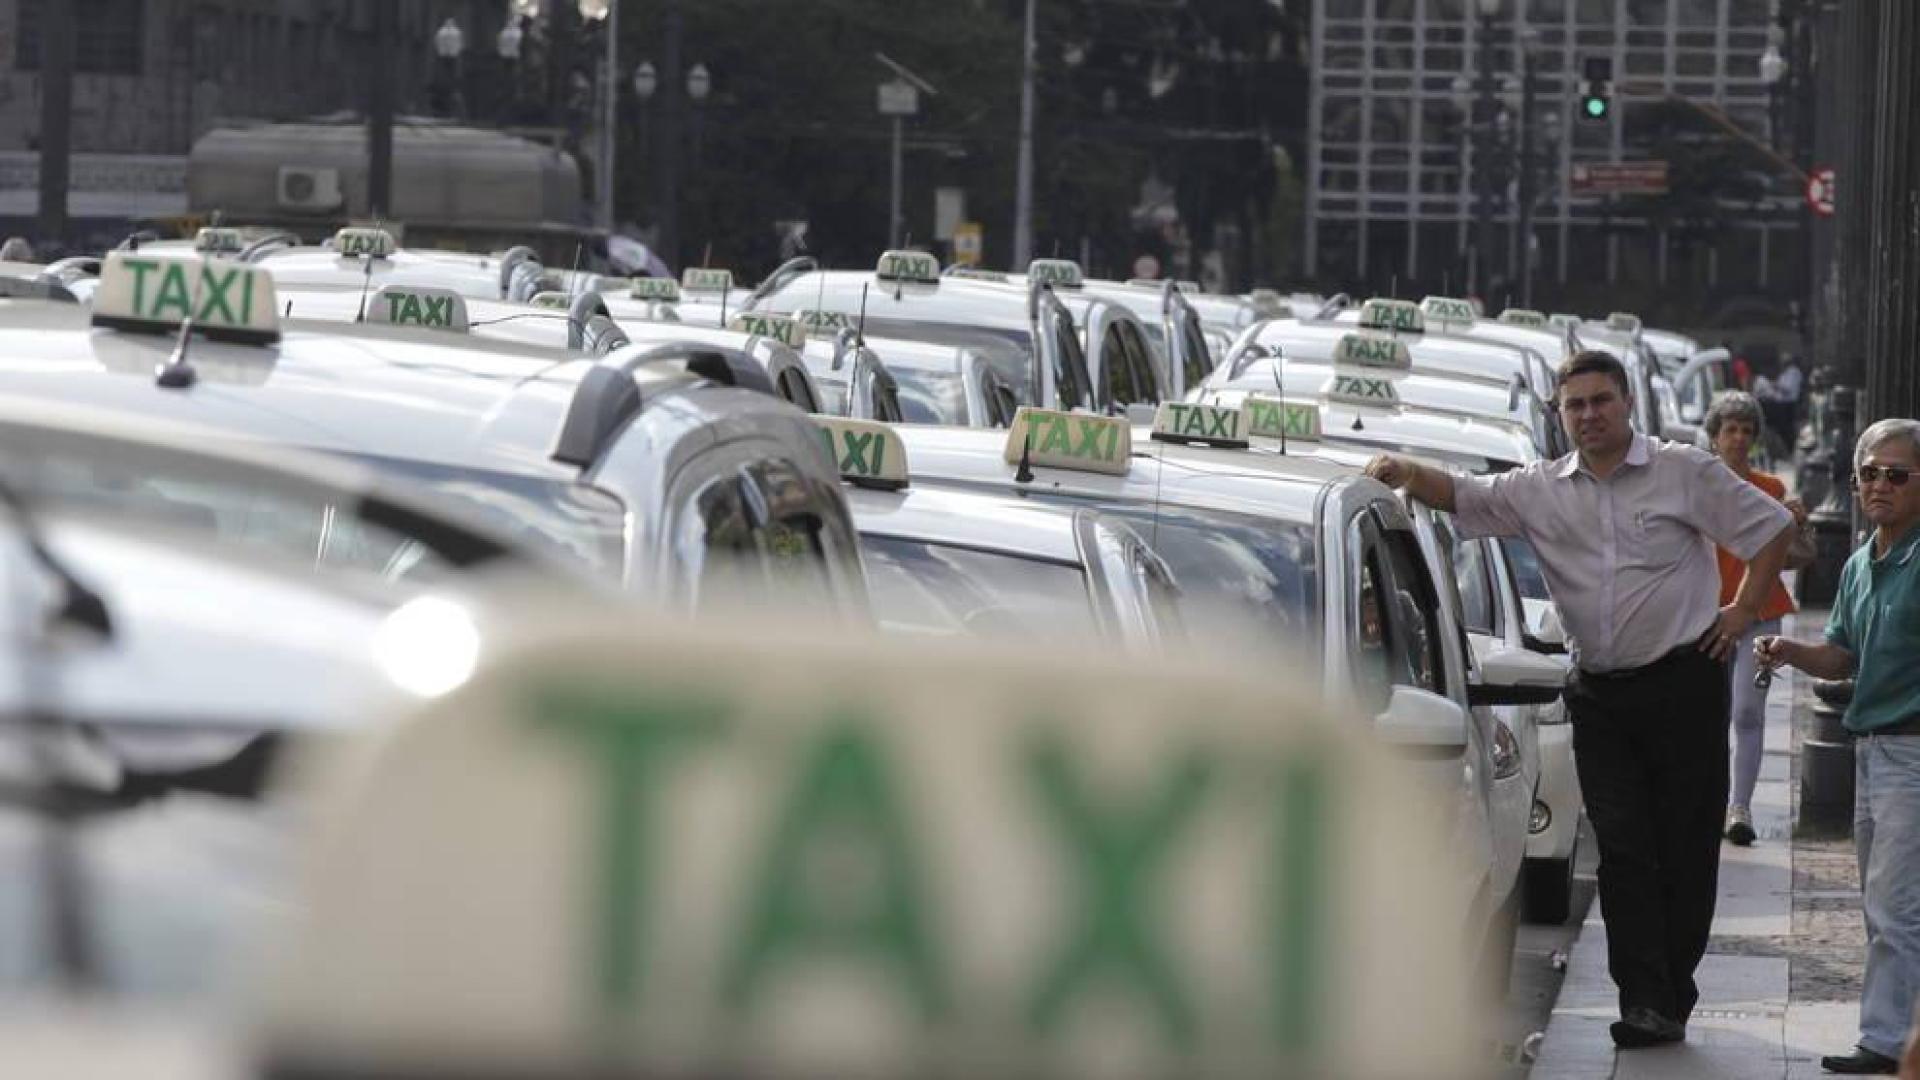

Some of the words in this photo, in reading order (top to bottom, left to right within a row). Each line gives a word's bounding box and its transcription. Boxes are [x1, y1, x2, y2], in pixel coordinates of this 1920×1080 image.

[341, 234, 386, 254] TAXI
[890, 256, 932, 277] TAXI
[122, 261, 255, 326] TAXI
[384, 292, 452, 327] TAXI
[1372, 303, 1415, 329] TAXI
[1427, 300, 1470, 318] TAXI
[741, 315, 793, 345] TAXI
[1343, 334, 1396, 361] TAXI
[1334, 375, 1394, 399] TAXI
[1169, 404, 1239, 439] TAXI
[1249, 402, 1312, 434] TAXI
[1022, 412, 1120, 461] TAXI
[520, 680, 1325, 1060] TAXI
